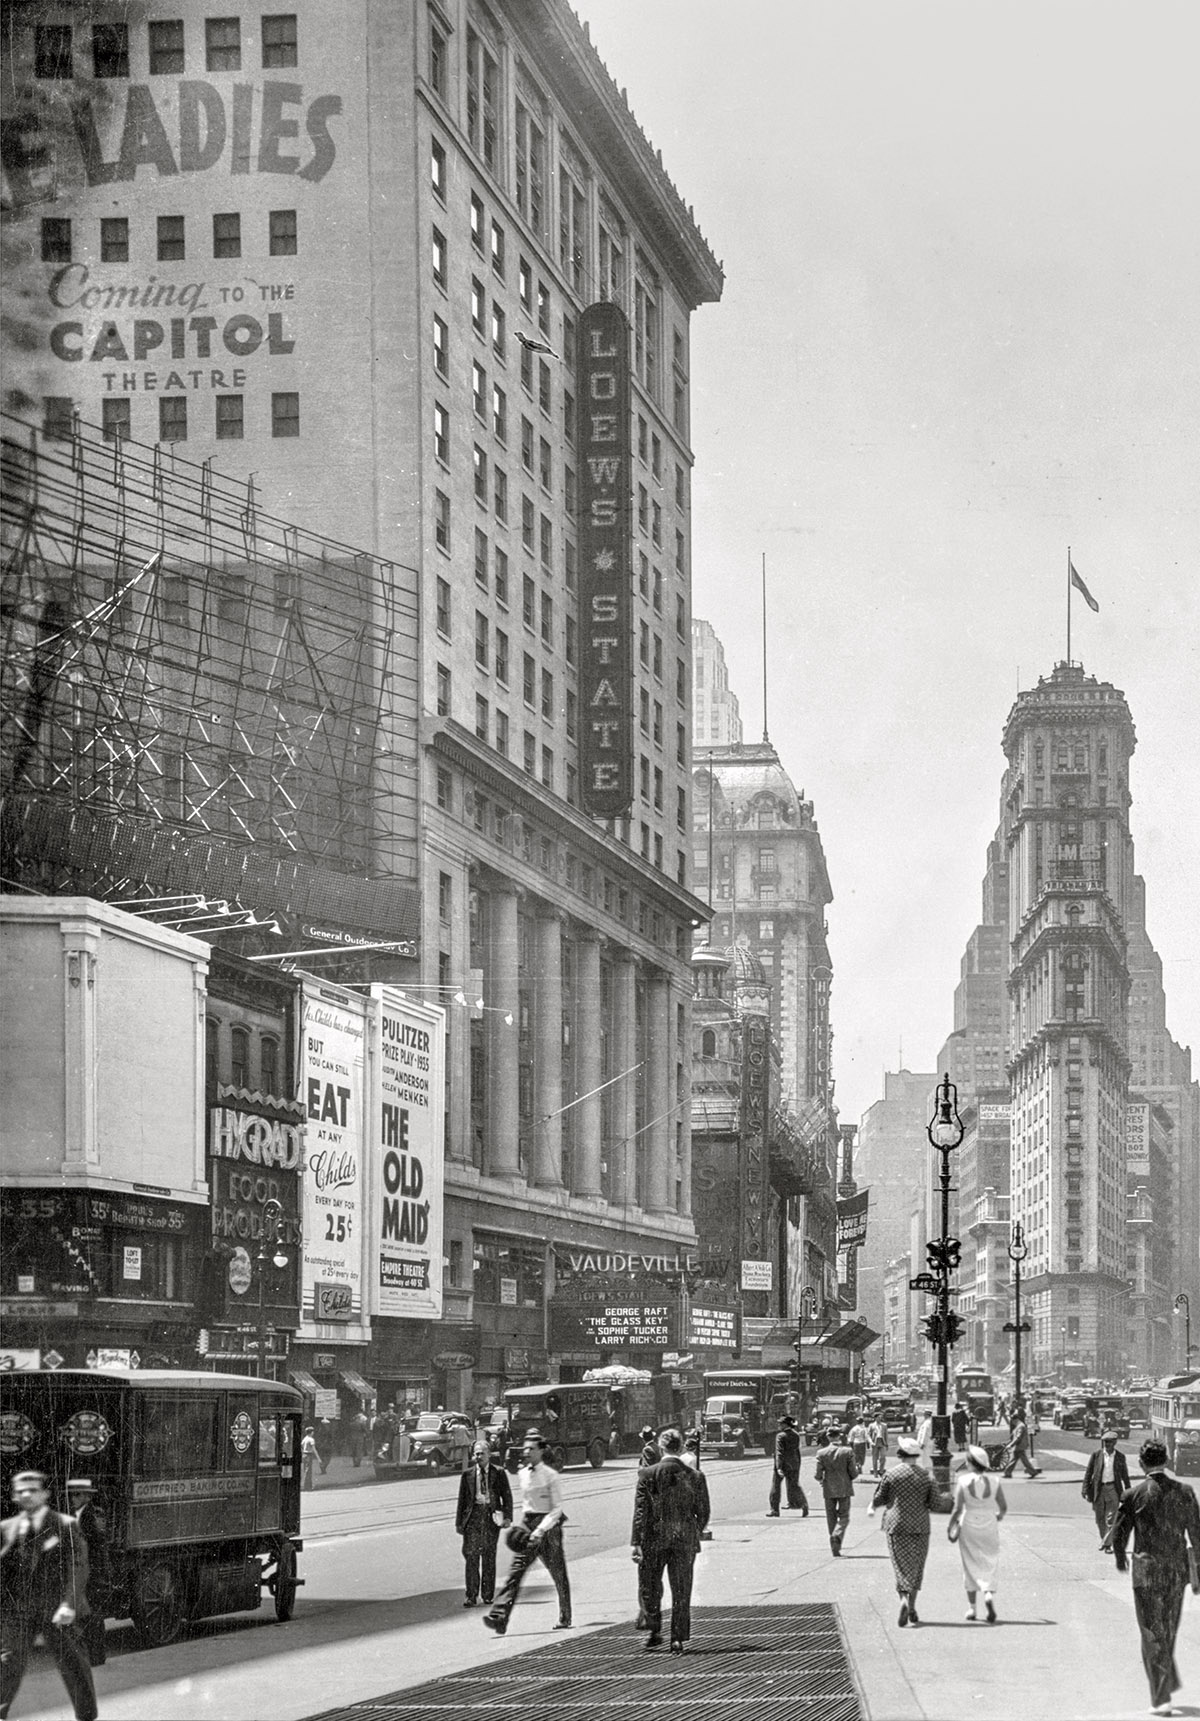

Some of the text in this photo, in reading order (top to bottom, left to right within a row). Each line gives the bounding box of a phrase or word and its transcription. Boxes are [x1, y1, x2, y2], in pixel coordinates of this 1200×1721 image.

[49, 263, 295, 315] Coming TO THE
[50, 312, 296, 362] CAPITOL
[103, 369, 247, 391] THEATRE
[587, 331, 621, 526] LOEW'S
[590, 595, 622, 790] STATE
[310, 926, 410, 954] General Co
[382, 1016, 430, 1053] PULITZER
[308, 1037, 324, 1055] BUT
[382, 1042, 399, 1062] PRIZE
[400, 1049, 414, 1067] PLAY
[308, 1055, 349, 1076] YOU CAN STILL
[394, 1070, 429, 1092] ANDERSON
[308, 1077, 351, 1128] EAT
[397, 1088, 429, 1108] MENKEN
[318, 1130, 343, 1144] AT ANY
[382, 1102, 409, 1150] THE
[309, 1150, 357, 1191] Childs
[383, 1151, 423, 1199] OLD
[749, 1148, 761, 1204] NEW
[230, 1171, 278, 1203] FOOD
[315, 1195, 355, 1210] EVERY DAY FOR
[325, 1213, 352, 1243] 25¢
[839, 1216, 858, 1230] LOVE
[382, 1261, 425, 1278] EMPIRE THEATRE
[569, 1254, 698, 1272] VAUDEVILLE
[336, 1269, 349, 1279] every
[350, 1271, 359, 1280] day
[383, 1276, 404, 1287] Broadway
[51, 1283, 90, 1293] WAVING
[585, 1316, 669, 1326] "THE GLASS KEY"
[605, 1307, 668, 1316] GEORGE RAFT
[595, 1336, 668, 1345] LARRY RICH CO
[598, 1326, 629, 1335] SOPHIE
[634, 1326, 668, 1335] TUCKER
